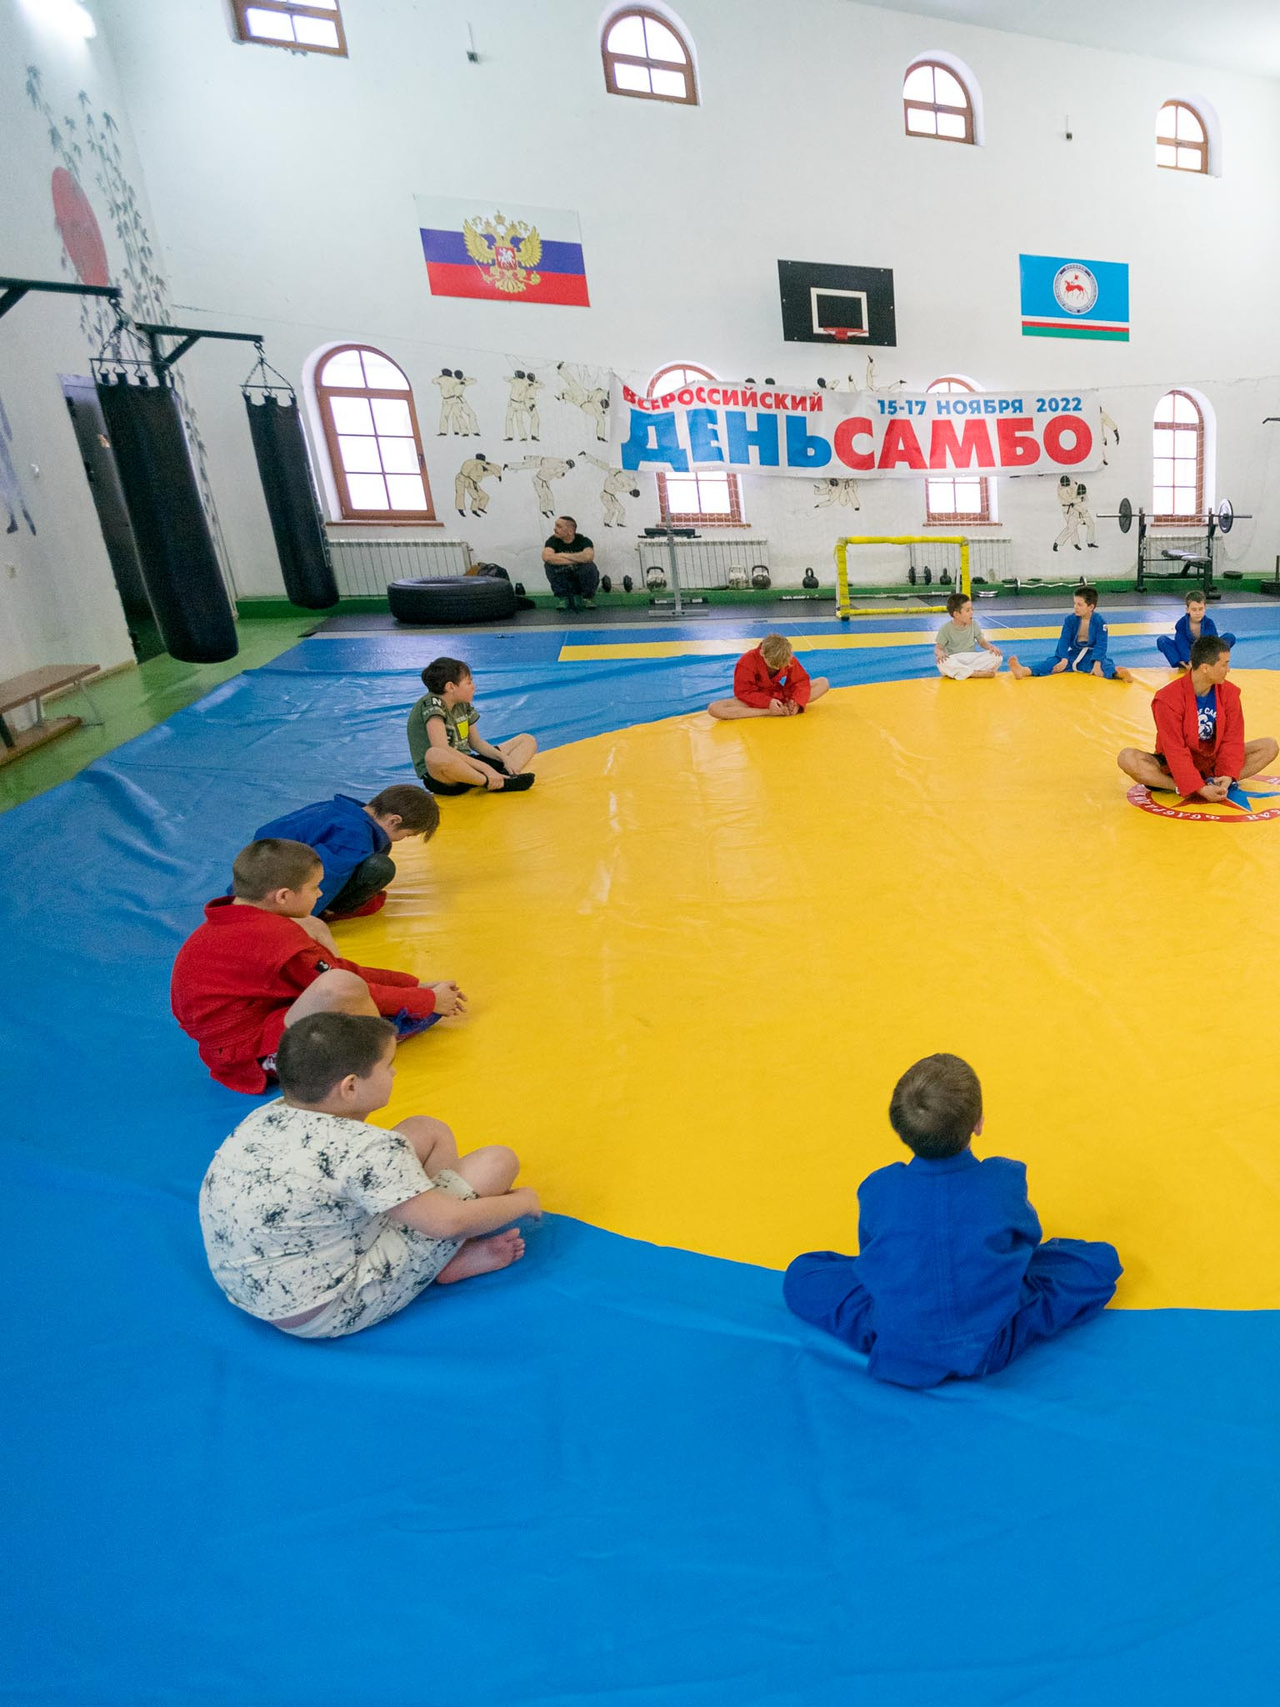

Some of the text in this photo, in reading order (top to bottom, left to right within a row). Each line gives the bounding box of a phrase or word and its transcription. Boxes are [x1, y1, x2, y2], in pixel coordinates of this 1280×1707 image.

[622, 385, 823, 412] ВСЕРОССИЙСКИЙ
[877, 397, 1083, 416] 15-17 НОЯБРЯ 2022
[621, 408, 1093, 472] ДЕНЬ САМБО
